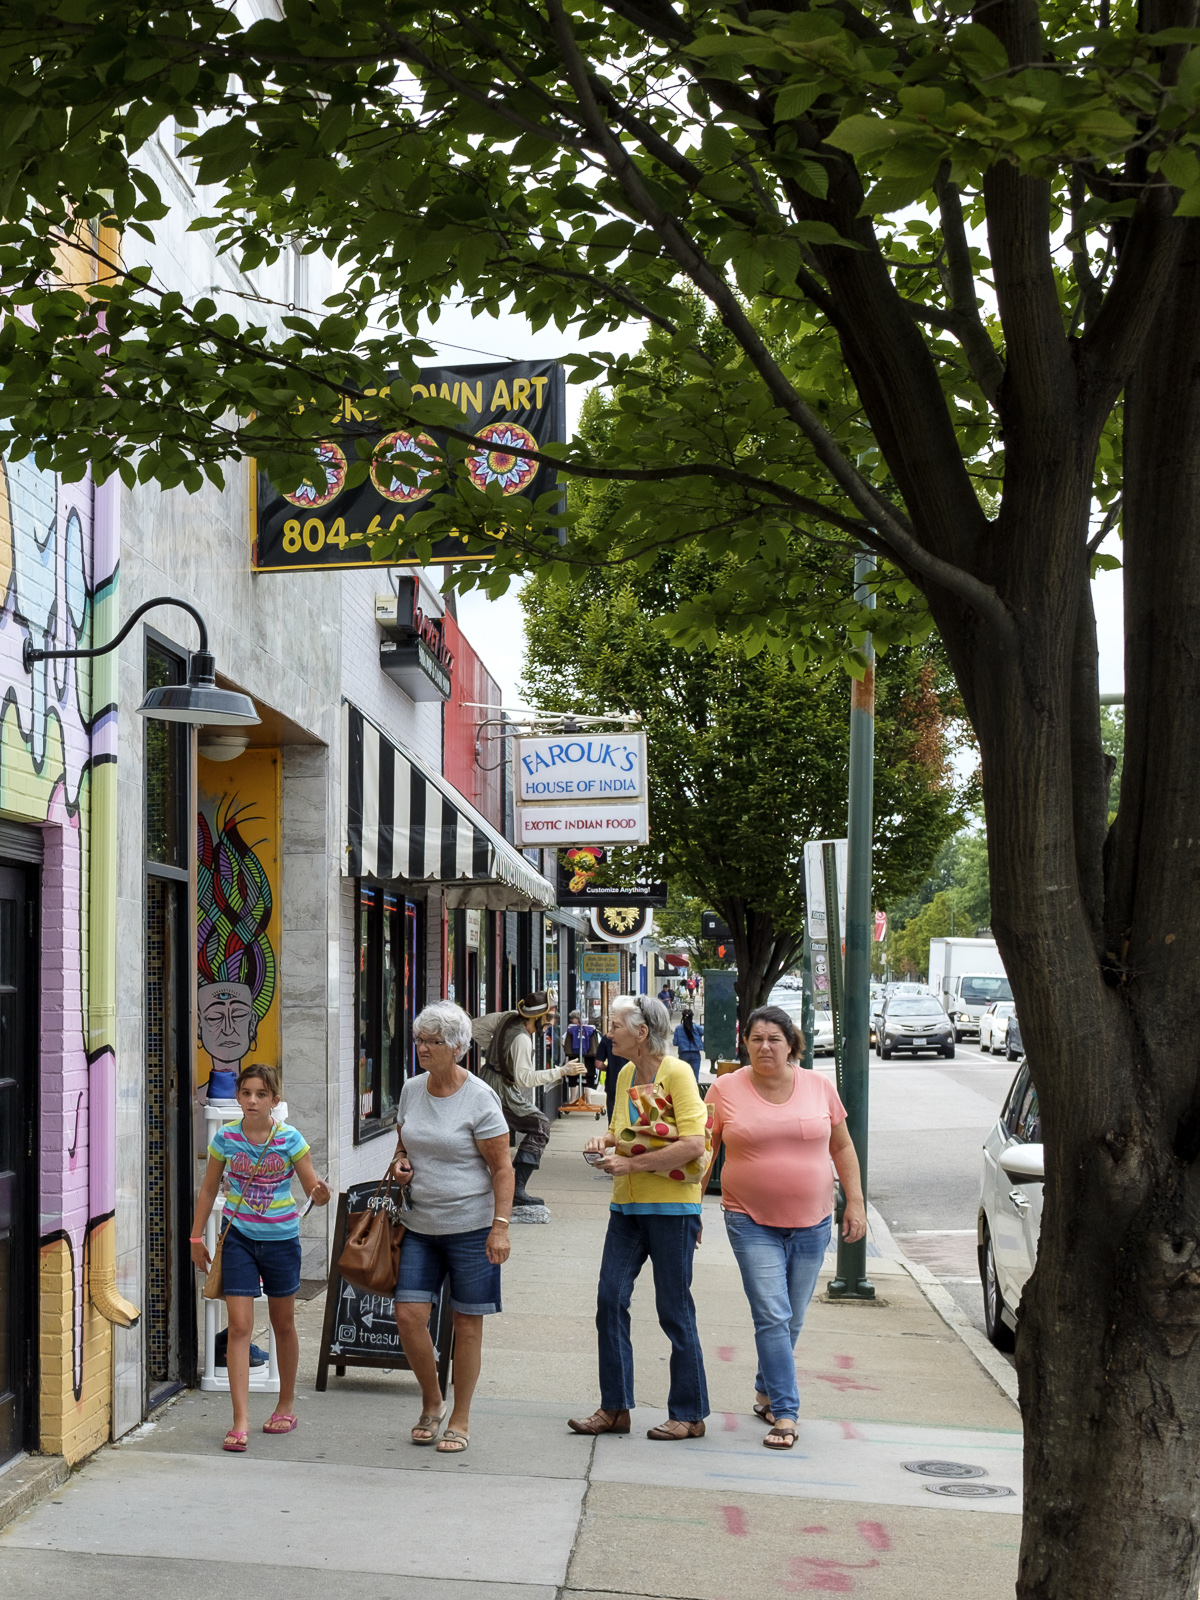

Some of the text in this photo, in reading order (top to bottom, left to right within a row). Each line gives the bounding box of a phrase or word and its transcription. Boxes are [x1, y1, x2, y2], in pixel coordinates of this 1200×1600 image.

[490, 376, 549, 411] ART
[522, 742, 638, 776] FAROUK'S
[526, 778, 637, 794] HOUSE OF INDIA
[524, 818, 637, 831] EXOTIC INDIAN FOOD
[620, 886, 651, 894] Anything!
